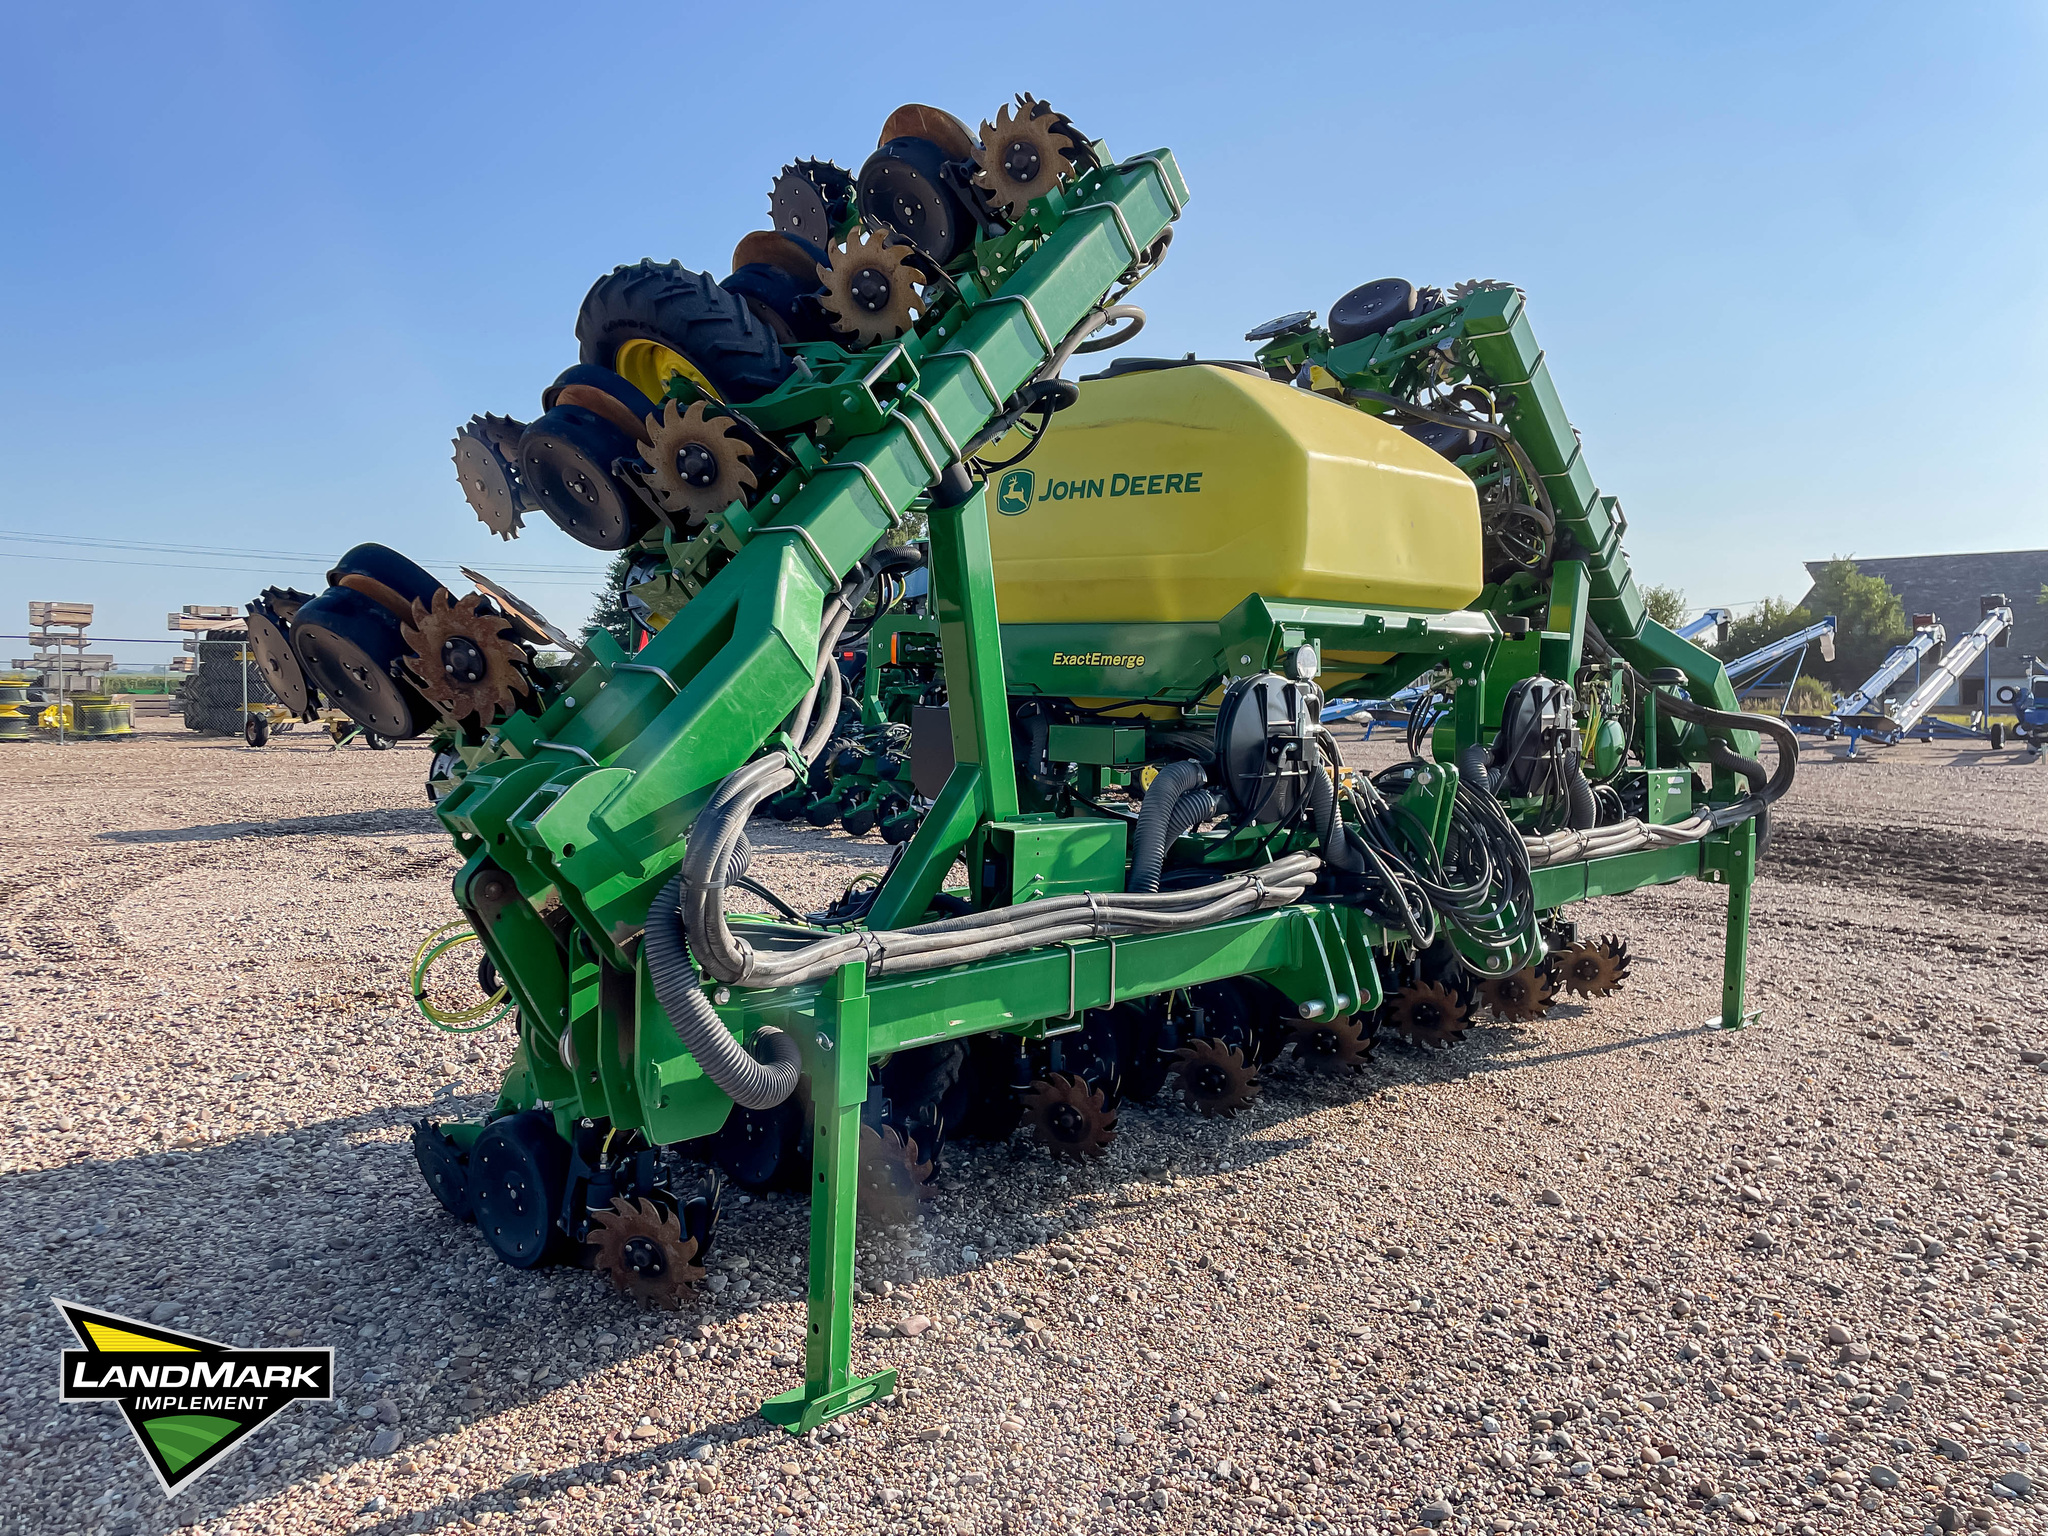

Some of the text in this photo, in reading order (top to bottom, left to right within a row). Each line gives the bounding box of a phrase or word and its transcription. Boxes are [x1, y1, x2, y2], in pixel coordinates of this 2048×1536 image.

[1038, 472, 1203, 501] JOHN DEERE
[1052, 652, 1146, 669] ExactEmerge
